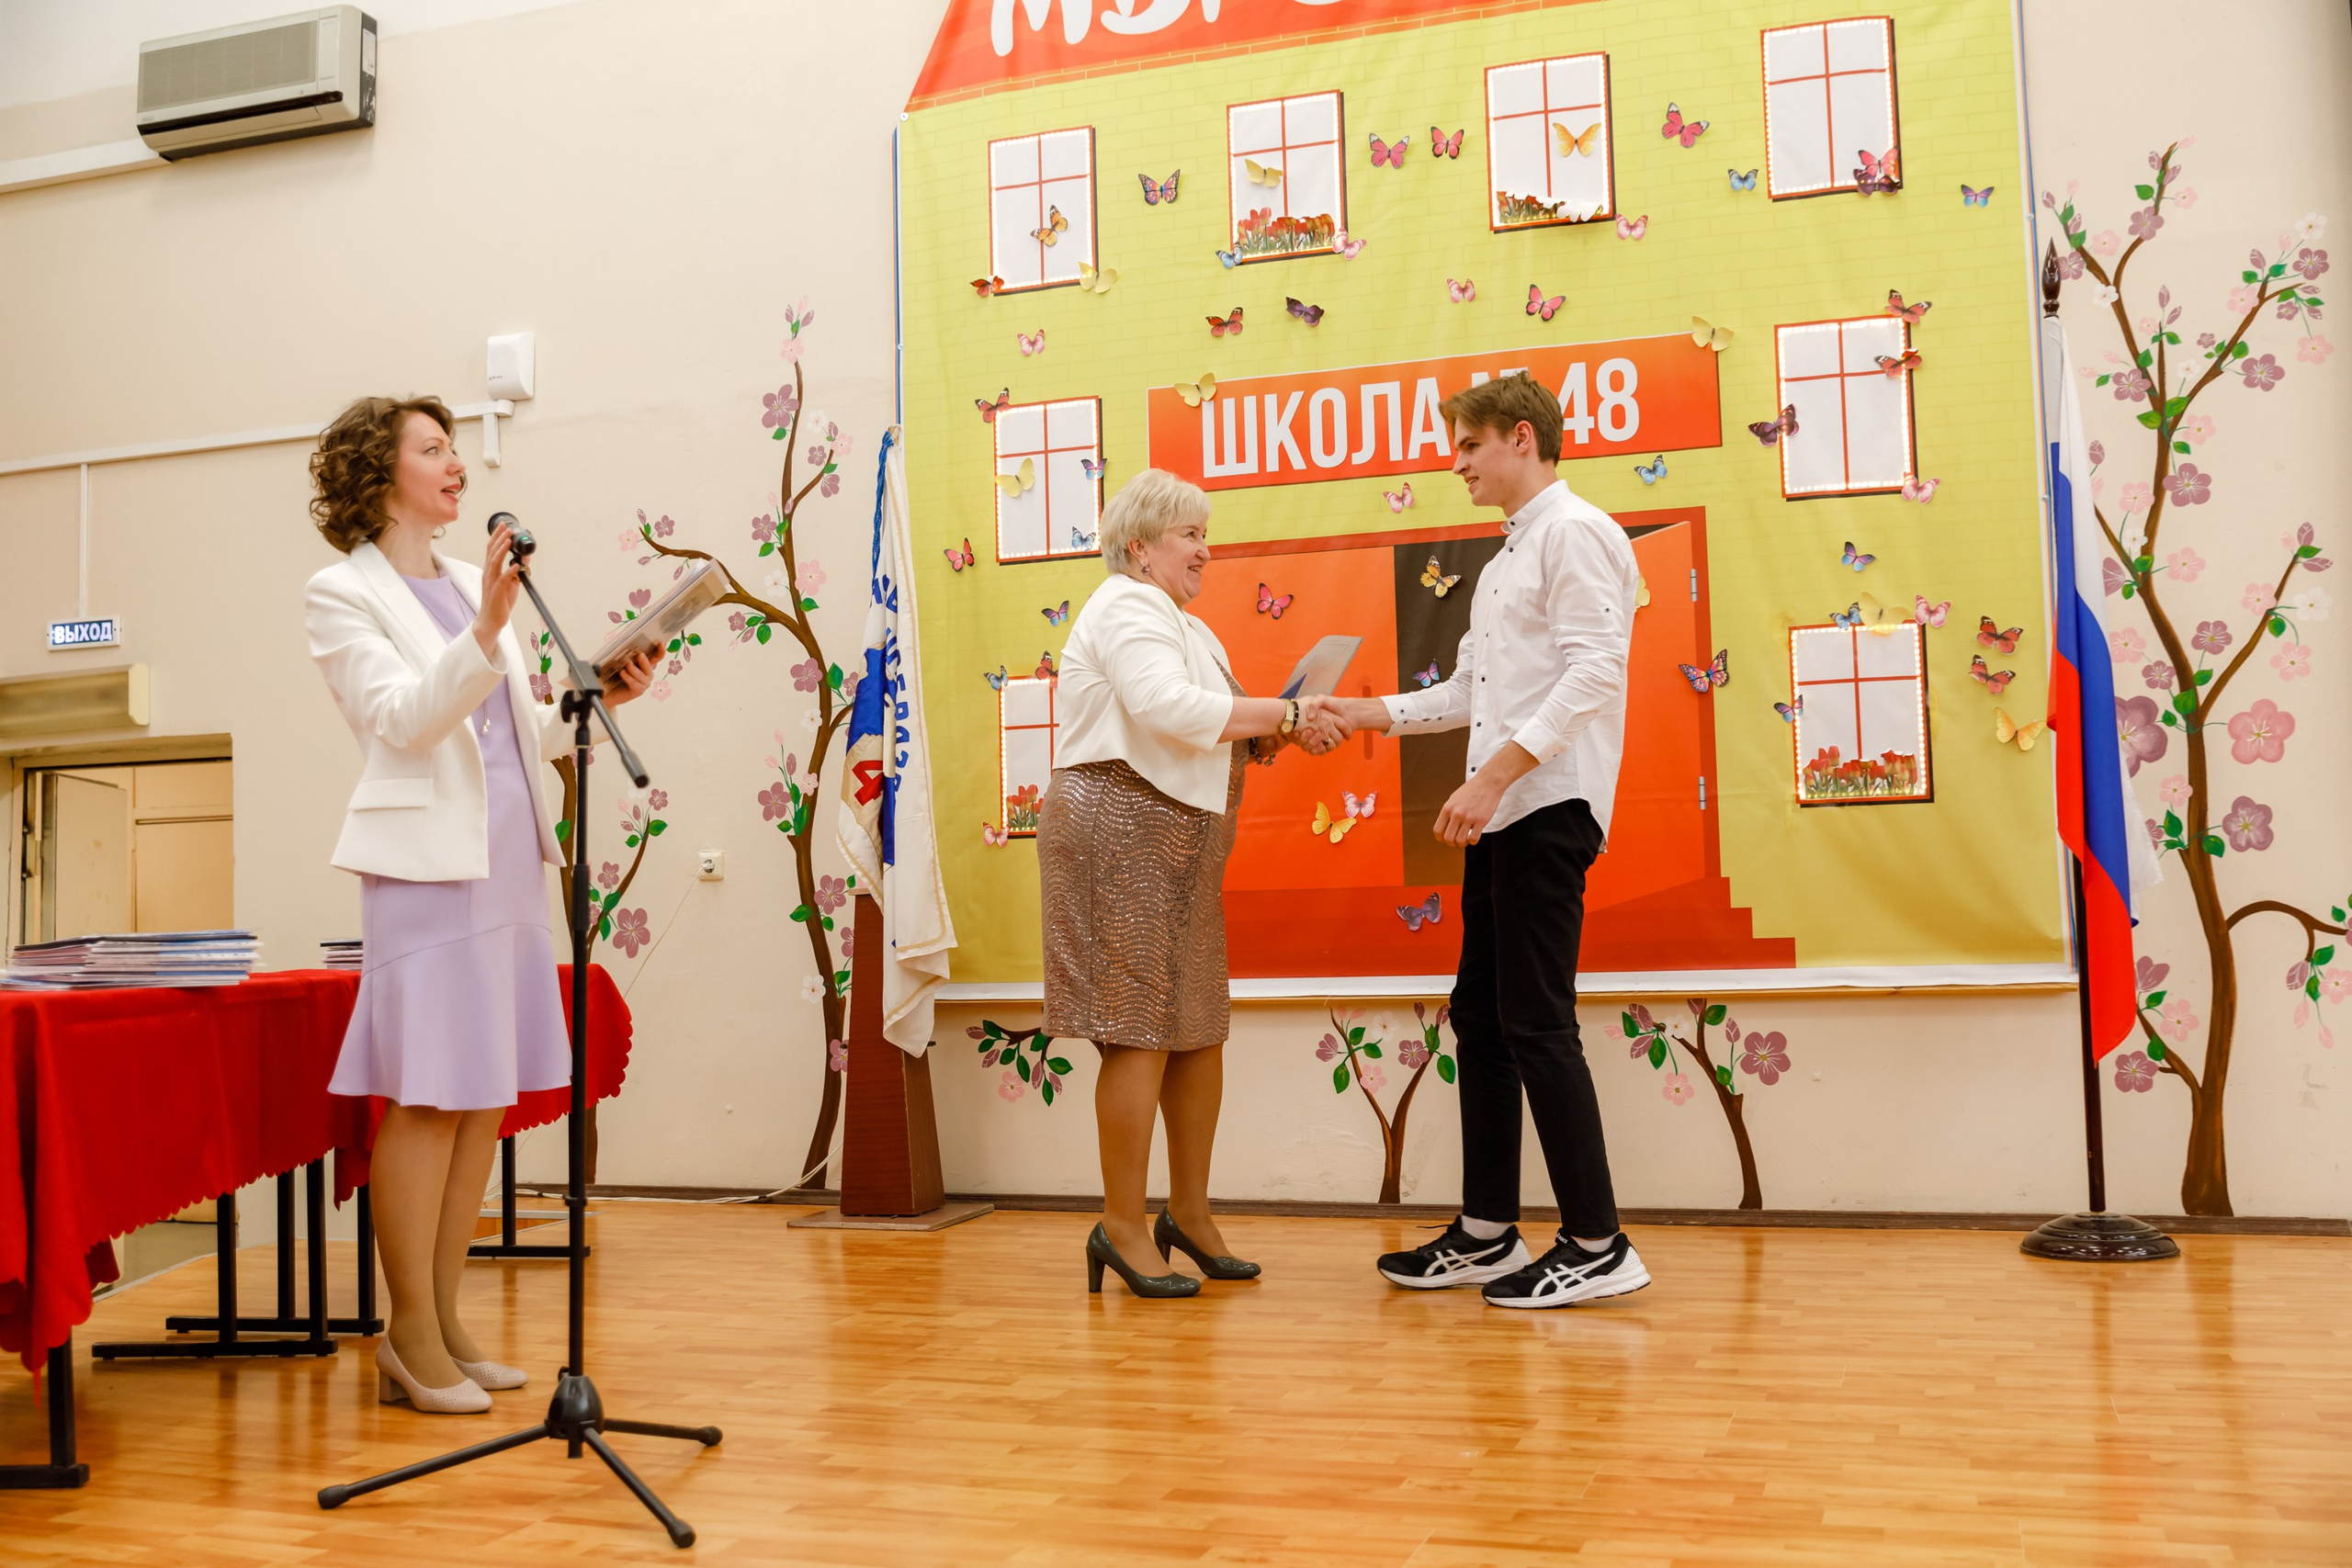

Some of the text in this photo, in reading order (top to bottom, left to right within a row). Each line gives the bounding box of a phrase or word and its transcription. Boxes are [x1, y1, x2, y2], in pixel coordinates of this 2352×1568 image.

[1202, 357, 1640, 479] ШКОЛА 48
[54, 622, 112, 644] ВЫХОД
